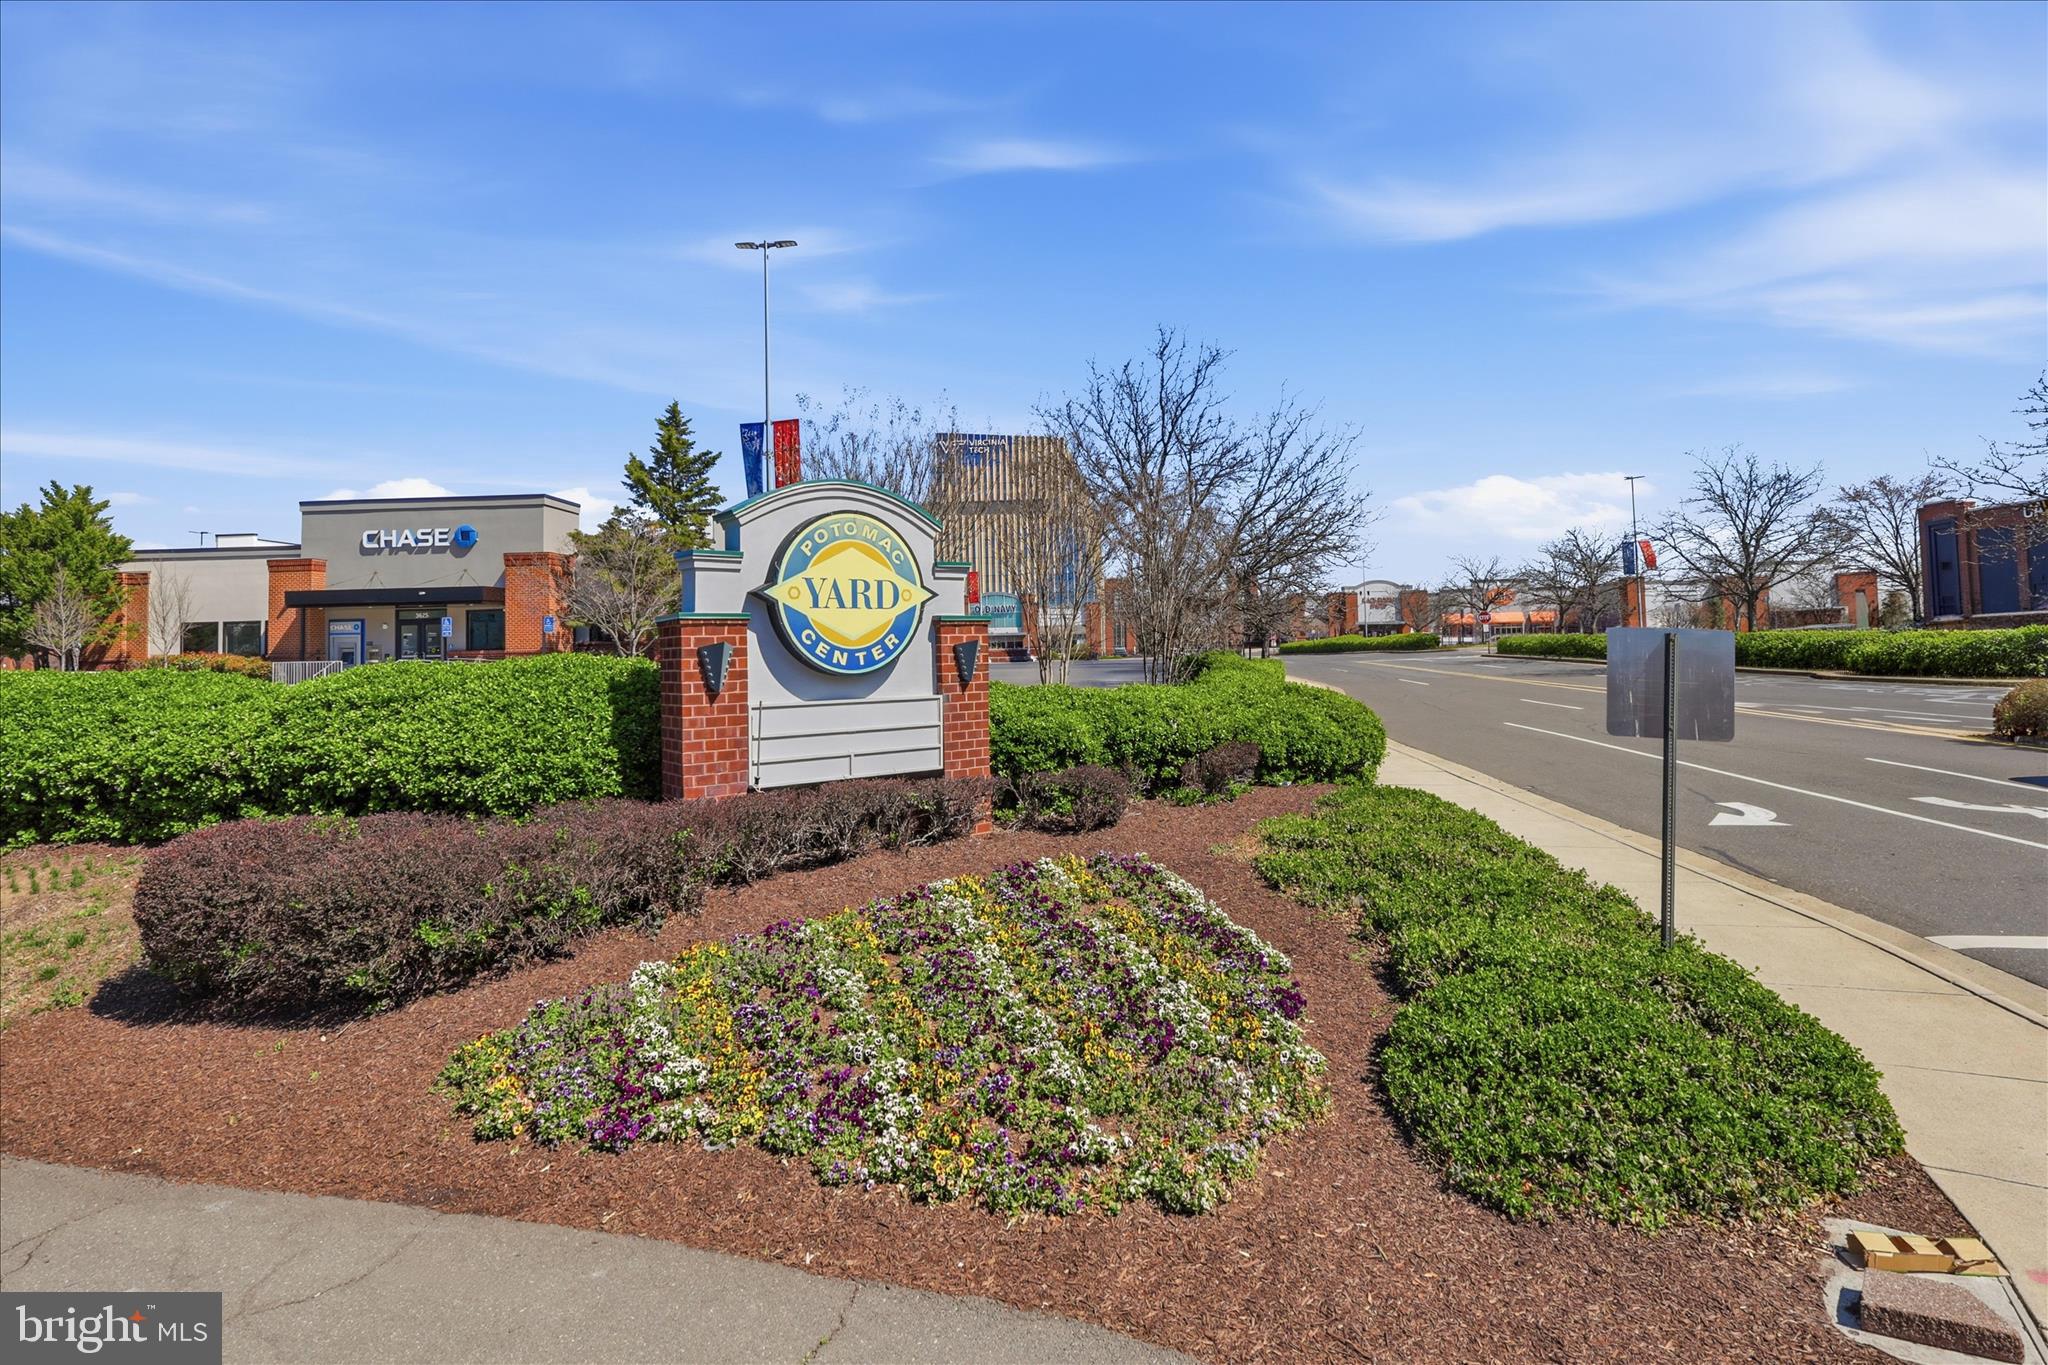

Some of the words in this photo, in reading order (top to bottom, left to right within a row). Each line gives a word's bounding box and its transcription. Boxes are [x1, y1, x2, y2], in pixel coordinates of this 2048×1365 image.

[362, 528, 450, 548] CHASE
[800, 522, 904, 564] POTOMAC
[802, 577, 900, 610] YARD
[330, 623, 353, 631] CHASE
[801, 629, 900, 665] CENTER
